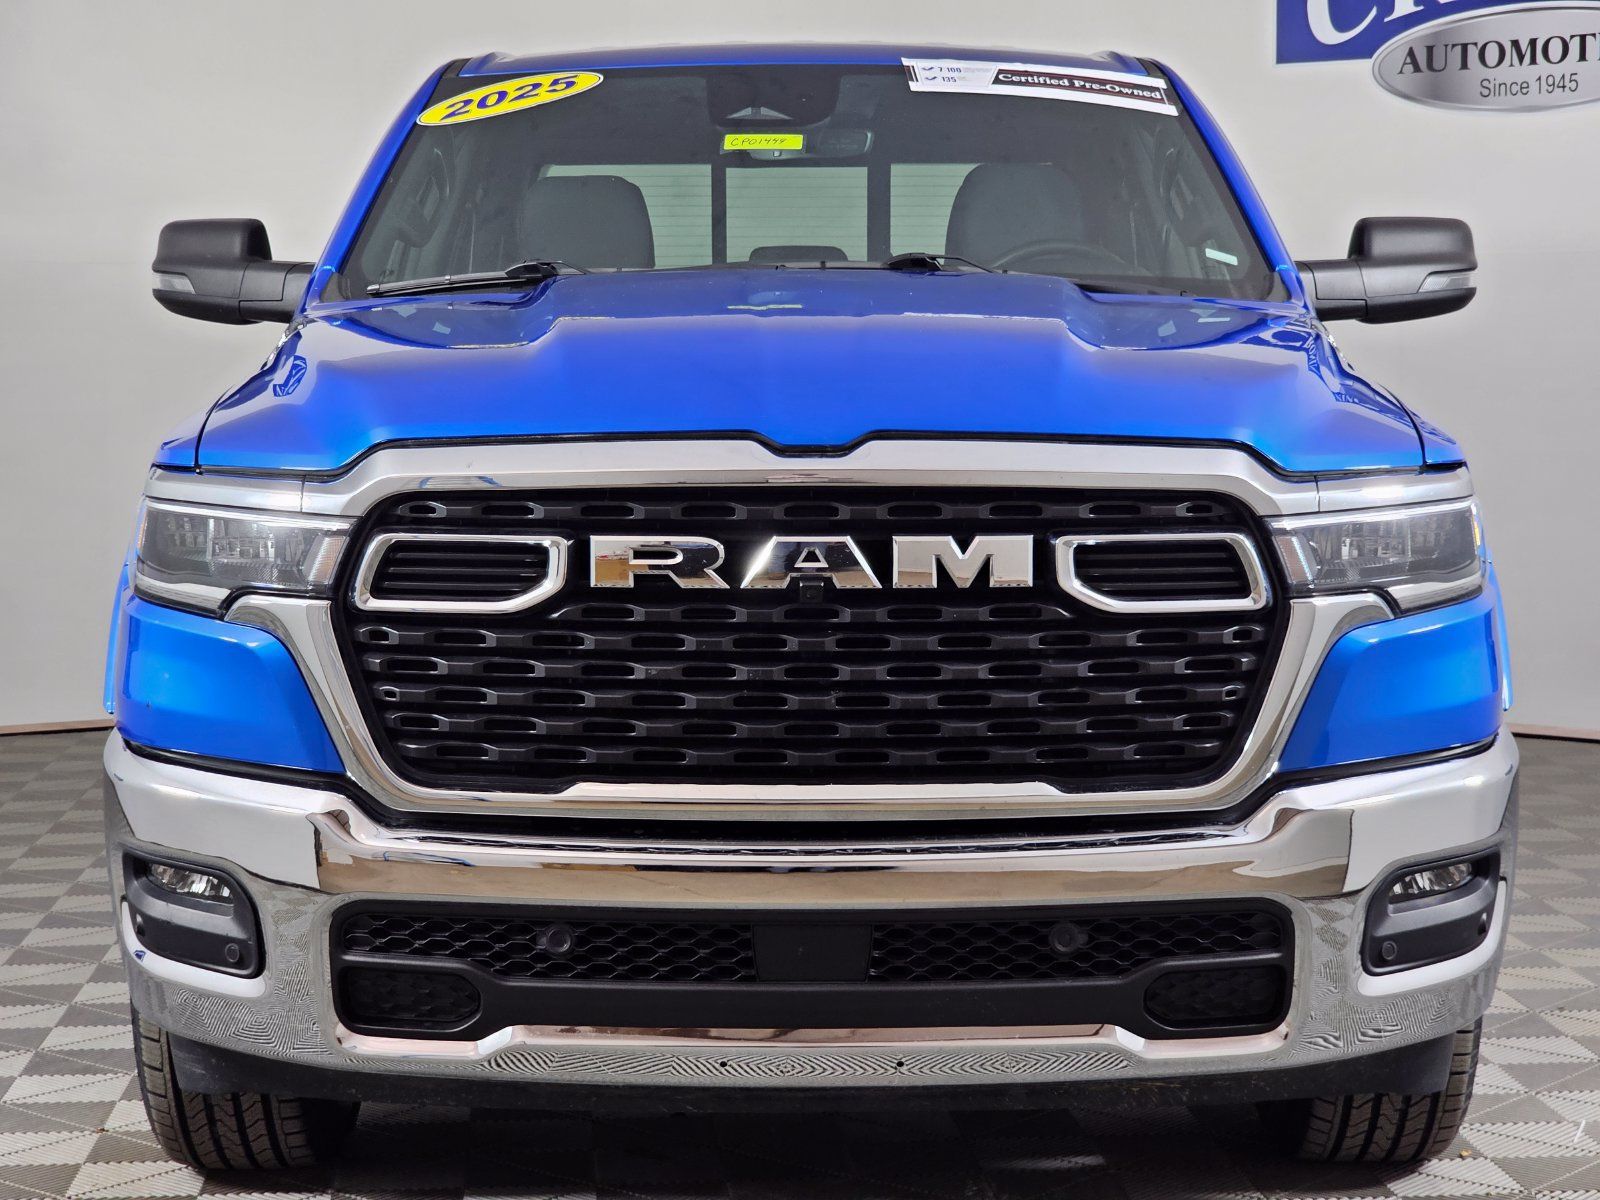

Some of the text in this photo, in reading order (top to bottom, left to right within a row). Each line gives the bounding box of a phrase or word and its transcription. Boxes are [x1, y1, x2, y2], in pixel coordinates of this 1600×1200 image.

[1397, 33, 1600, 75] AUTOMOT
[440, 75, 580, 121] 2025
[998, 73, 1162, 99] Certified Pre-Owned
[1480, 72, 1579, 98] Since 1945
[590, 535, 1034, 589] RAM
